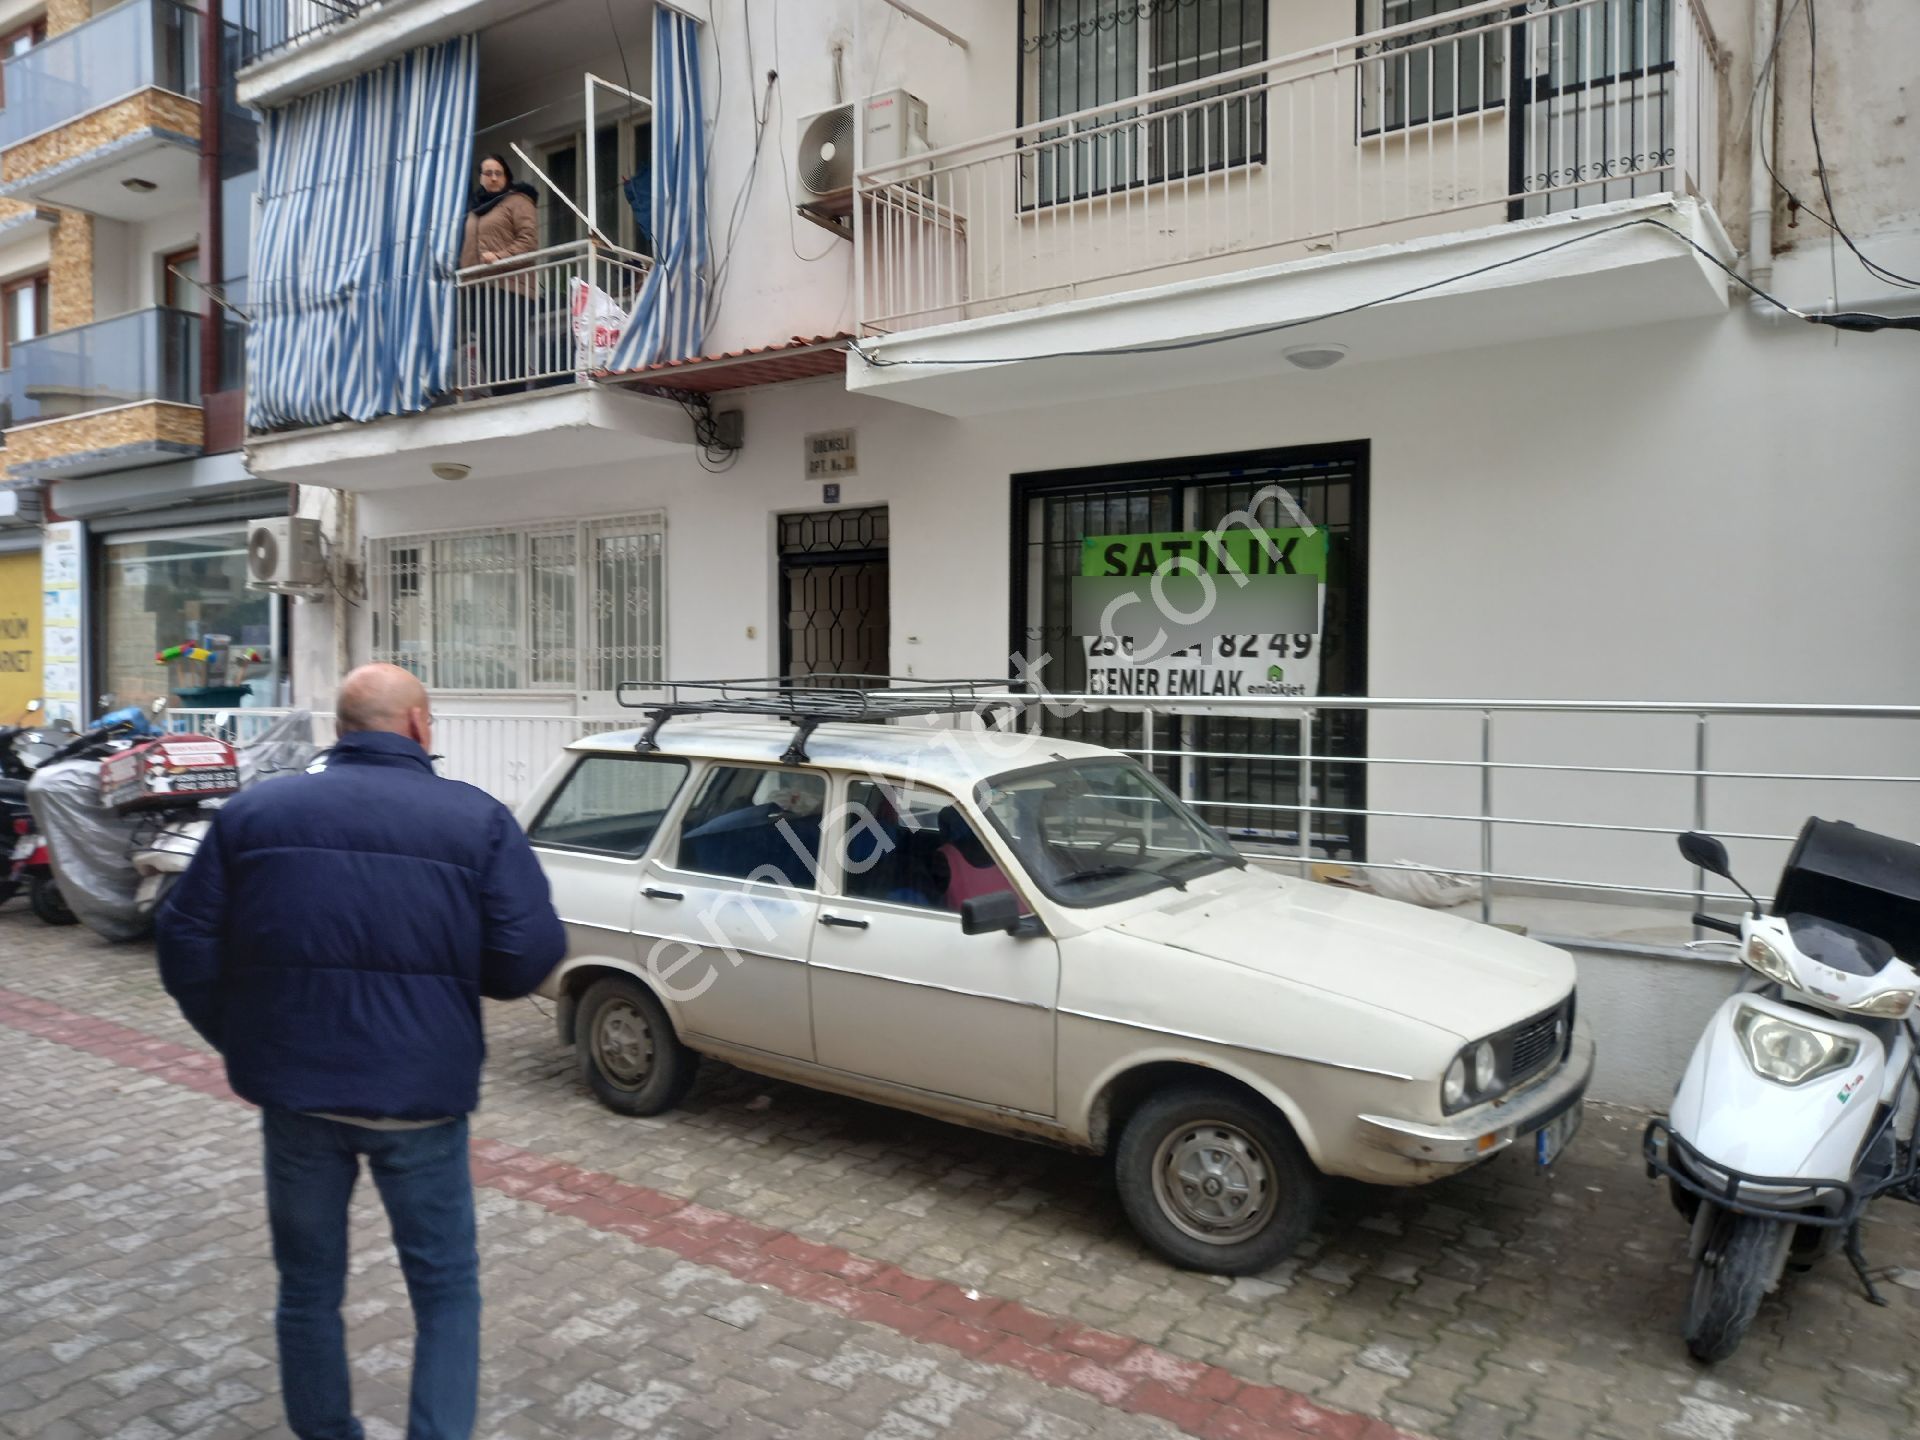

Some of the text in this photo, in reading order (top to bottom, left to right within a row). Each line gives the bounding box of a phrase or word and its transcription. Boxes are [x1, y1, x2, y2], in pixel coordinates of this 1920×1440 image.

[1104, 537, 1300, 576] SATILIK
[1218, 633, 1259, 659] 82
[1267, 632, 1313, 660] 49
[1167, 669, 1244, 697] EMLAK
[1247, 683, 1306, 697] emlakjet
